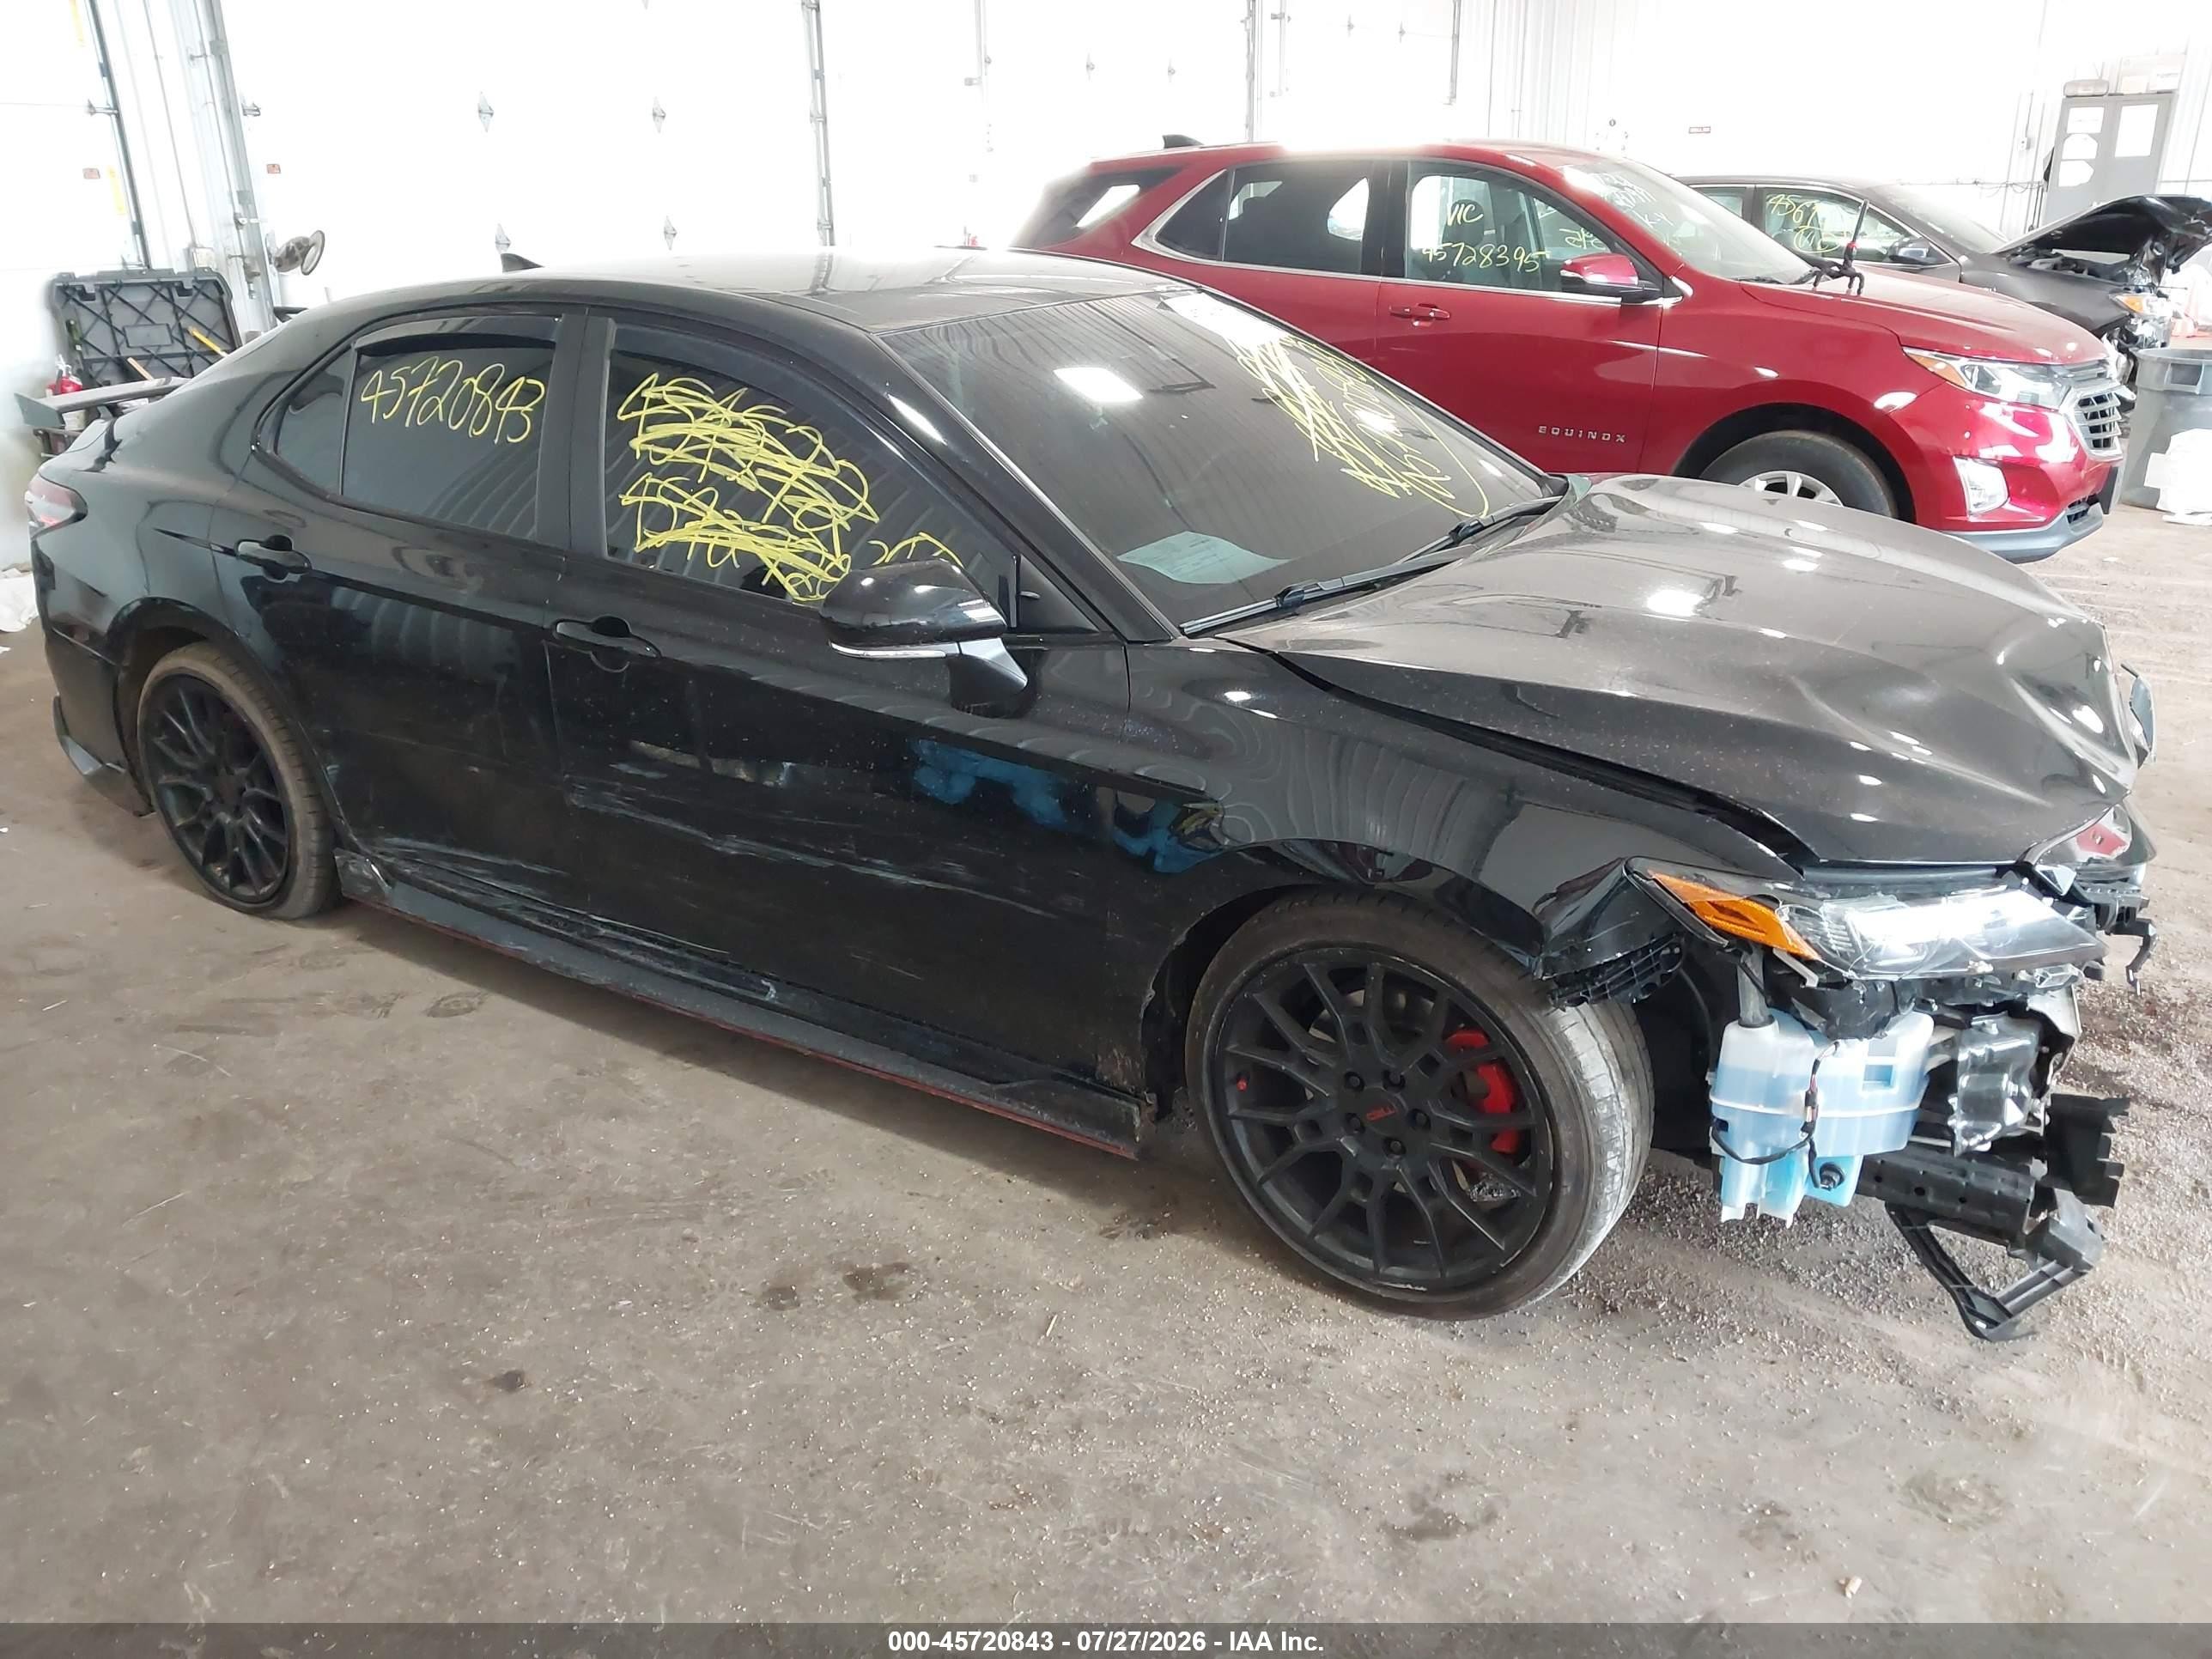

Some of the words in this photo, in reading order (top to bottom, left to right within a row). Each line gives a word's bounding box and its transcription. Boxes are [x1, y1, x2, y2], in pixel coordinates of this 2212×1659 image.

[1447, 203, 1485, 226] VIC
[361, 356, 545, 445] 45720843
[1538, 425, 1626, 443] EQUINOX
